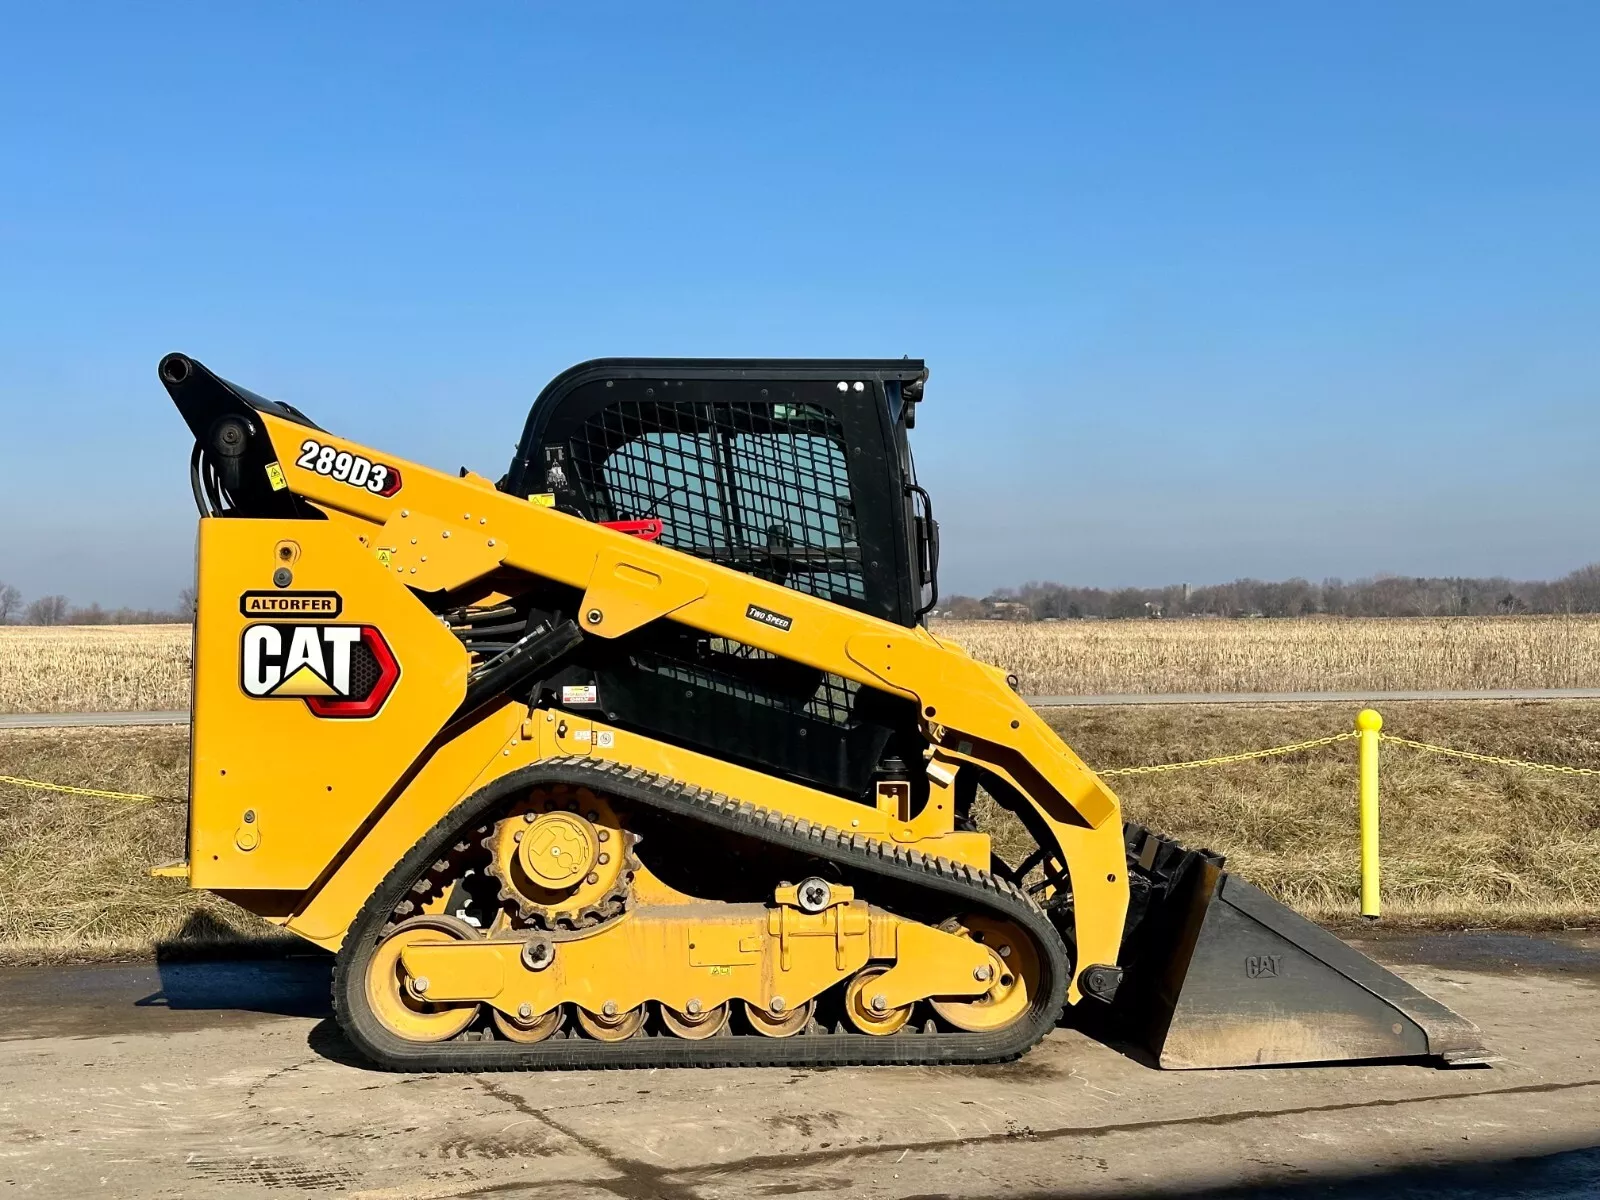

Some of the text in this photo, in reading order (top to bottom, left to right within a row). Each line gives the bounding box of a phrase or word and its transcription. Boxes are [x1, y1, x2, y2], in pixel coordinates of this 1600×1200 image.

[297, 440, 388, 493] 289D3
[250, 598, 333, 611] ALTORFER
[749, 607, 789, 628] TWO SPEED
[243, 624, 361, 696] CAT
[1245, 954, 1282, 979] CAT
